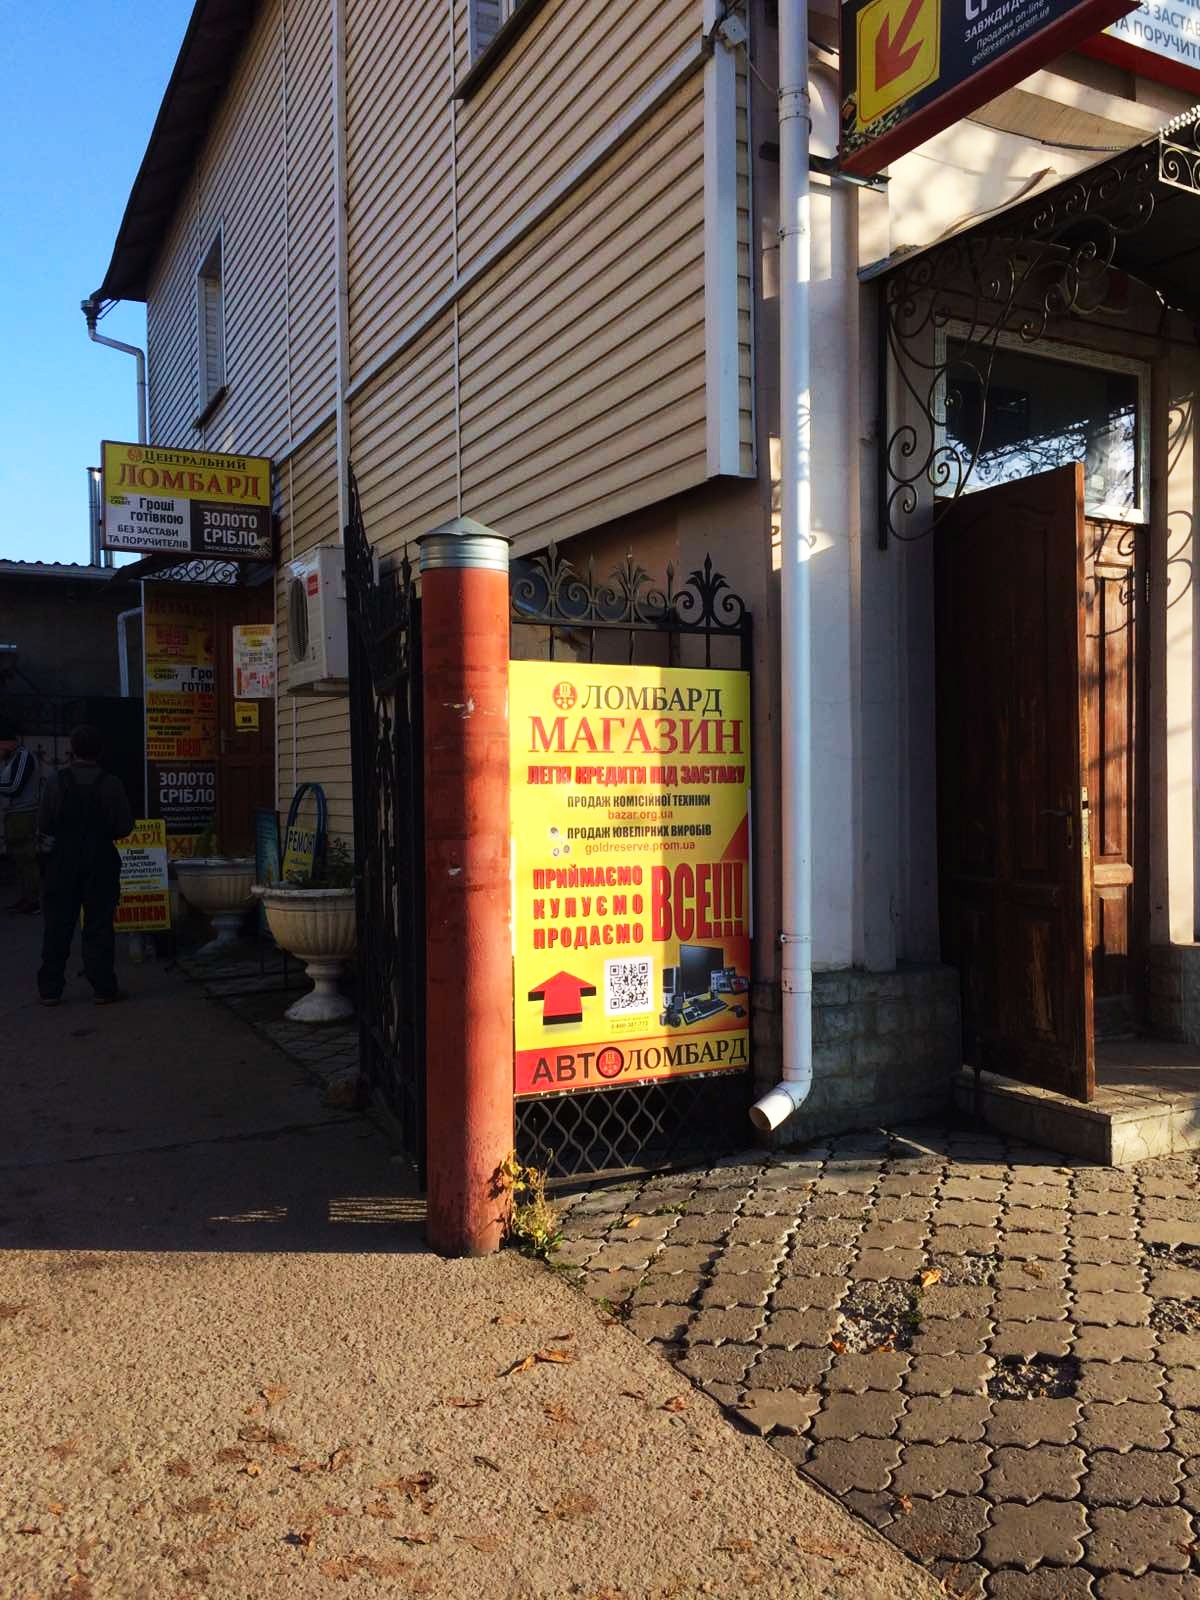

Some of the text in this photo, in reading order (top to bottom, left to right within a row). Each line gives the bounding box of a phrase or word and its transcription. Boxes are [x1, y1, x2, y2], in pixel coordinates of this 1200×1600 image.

[964, 4, 1010, 42] ЗАВЖДИ
[143, 450, 247, 470] ЦЕНТРАЛЬНИЙ
[116, 464, 261, 500] ЛОМБАРД
[139, 497, 174, 511] Гроші
[130, 511, 184, 525] готівкою
[203, 511, 257, 529] ЗОЛОТО
[117, 524, 178, 537] БЕЗ ЗАСТАВИ
[203, 528, 257, 546] СРІБЛО
[108, 535, 188, 548] ТА ПОРУЧИТЕЛІВ
[182, 683, 215, 692] готів
[581, 685, 723, 717] ЛОМБАРД
[527, 716, 744, 754] МАГАЗИН
[159, 771, 215, 786] ЗОЛОТО
[575, 766, 647, 786] КРЕДИТИ
[650, 766, 678, 786] ПІД
[680, 765, 745, 785] ЗАСТАВУ
[159, 788, 215, 803] СРІБЛО
[567, 794, 711, 808] ПРОДАЖ КОМІСІЙНОЇ ТЕХНІКИ
[608, 809, 673, 822] bazar.org.ua
[567, 824, 712, 840] ПРОДАЖ ЮВЕЛІРНИХ ВИРОБІВ
[585, 841, 695, 855] goldreserve.prom.ua
[533, 865, 643, 889] ПРИЙМАЄМО
[533, 894, 644, 920] КУПУЄМО
[651, 862, 744, 942] ВСЕ!!!
[533, 923, 644, 950] ПРОДАЄМО
